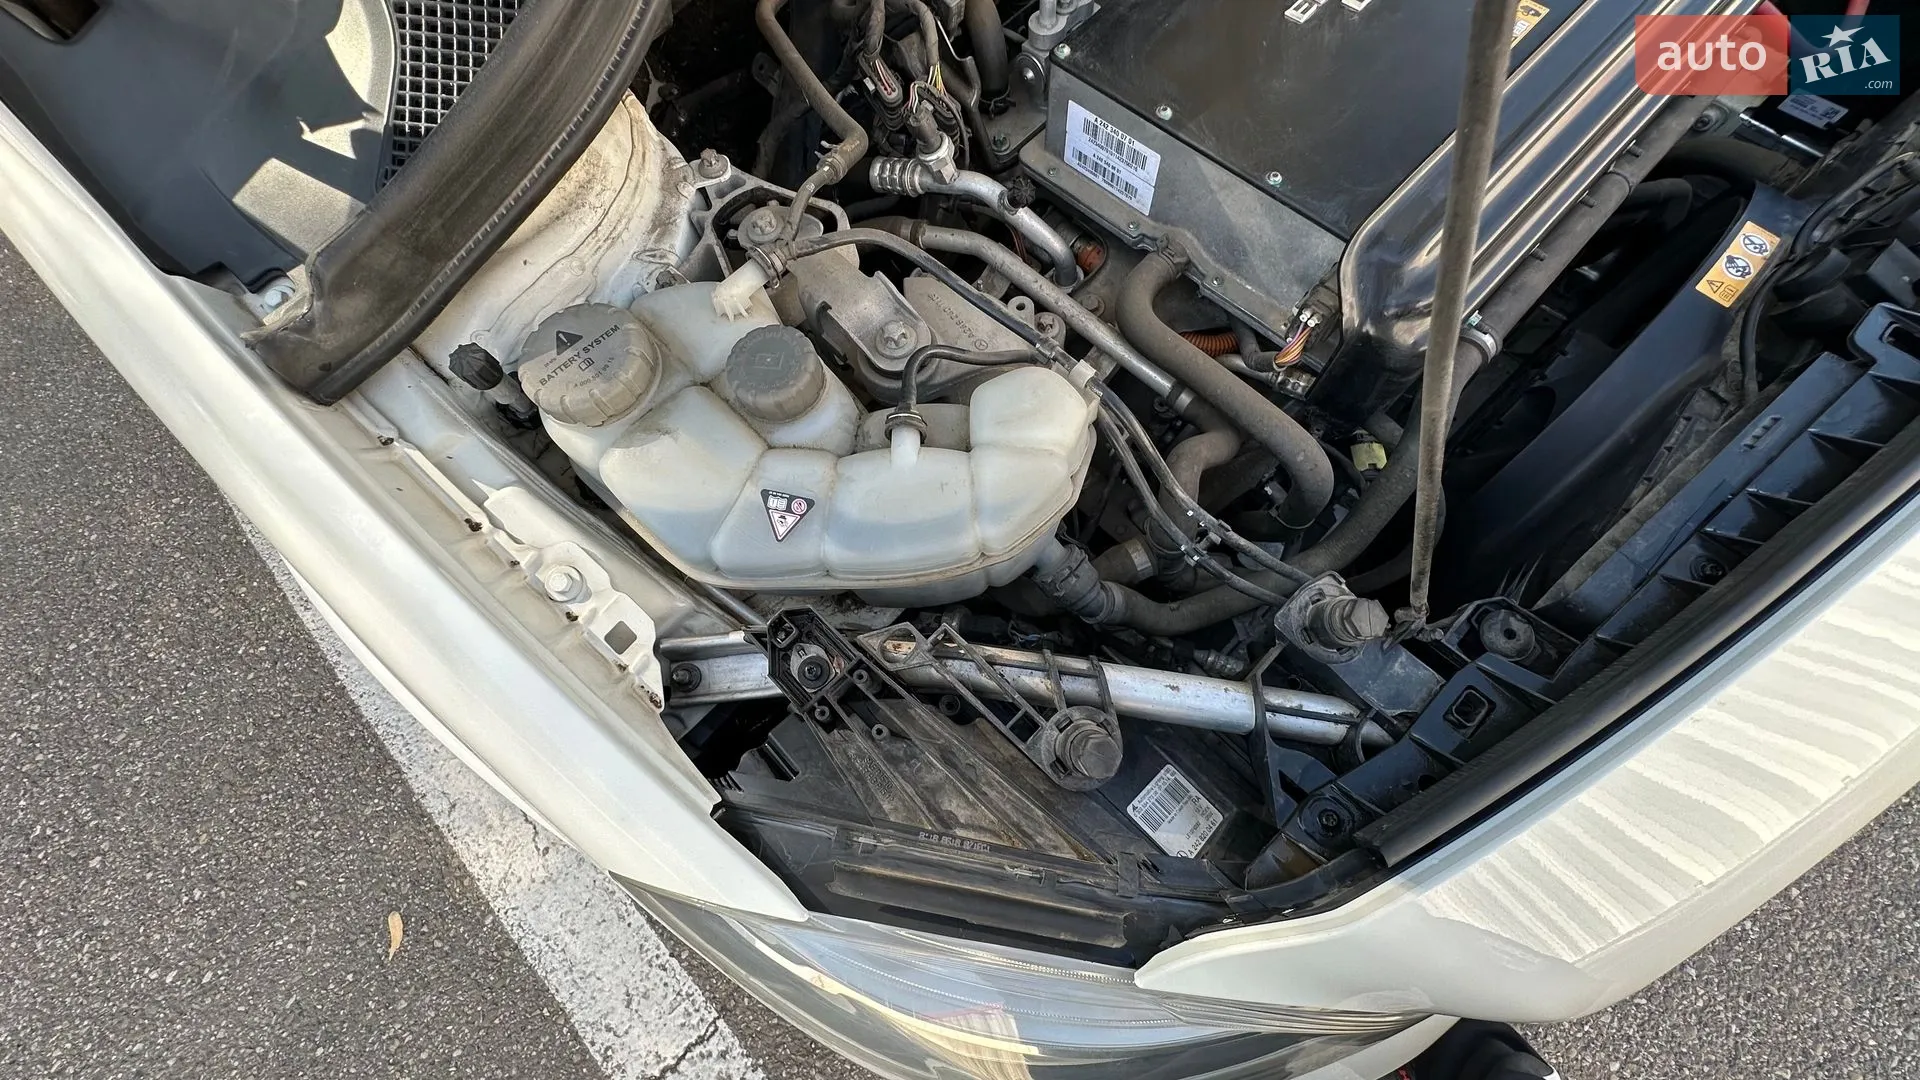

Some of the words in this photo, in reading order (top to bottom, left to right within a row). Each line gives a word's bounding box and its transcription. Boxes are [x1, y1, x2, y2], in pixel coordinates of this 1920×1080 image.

[539, 351, 582, 386] BATTERY
[582, 324, 620, 354] SYSTEM
[1191, 795, 1202, 805] RA
[1191, 840, 1202, 851] 242
[1199, 831, 1208, 842] 820
